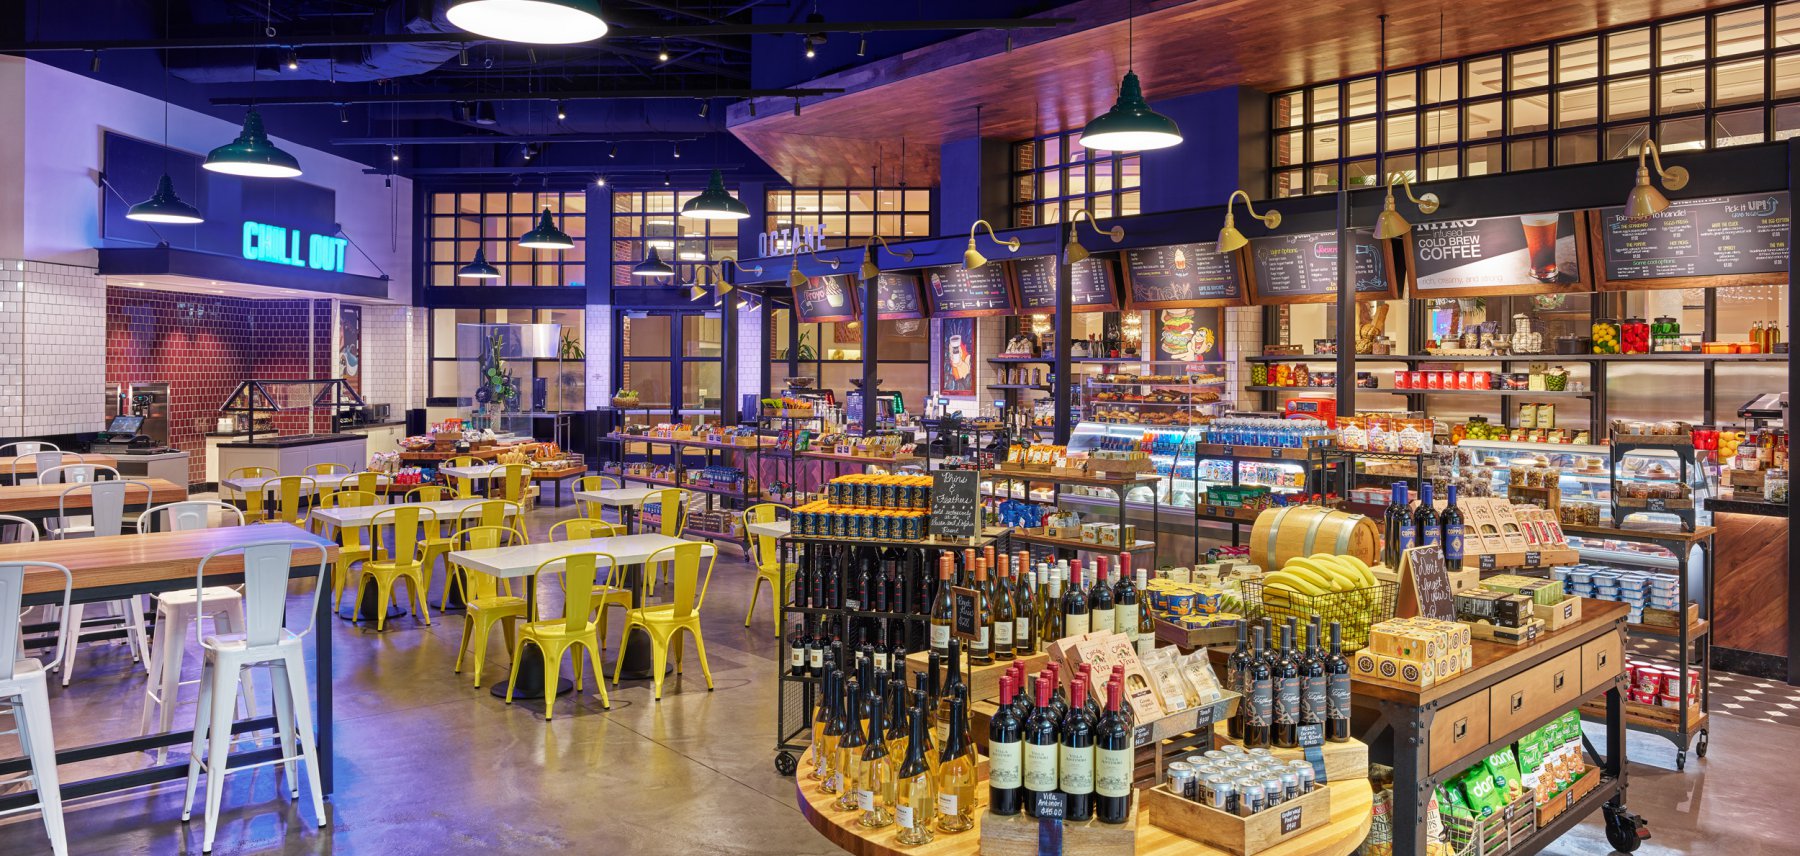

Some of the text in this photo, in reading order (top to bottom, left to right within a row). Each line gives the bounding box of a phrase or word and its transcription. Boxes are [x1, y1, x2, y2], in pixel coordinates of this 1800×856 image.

[1725, 205, 1739, 213] Pick
[1748, 200, 1767, 211] UP!
[758, 223, 827, 258] OCTANE
[1418, 235, 1480, 248] COLD BREW
[242, 221, 348, 273] CHILL OUT
[1420, 245, 1481, 260] COFFEE
[937, 494, 972, 503] Feathers
[1119, 656, 1135, 666] Viva
[1093, 663, 1110, 674] Viva
[1043, 792, 1057, 801] Villa
[1038, 798, 1063, 808] Antinori
